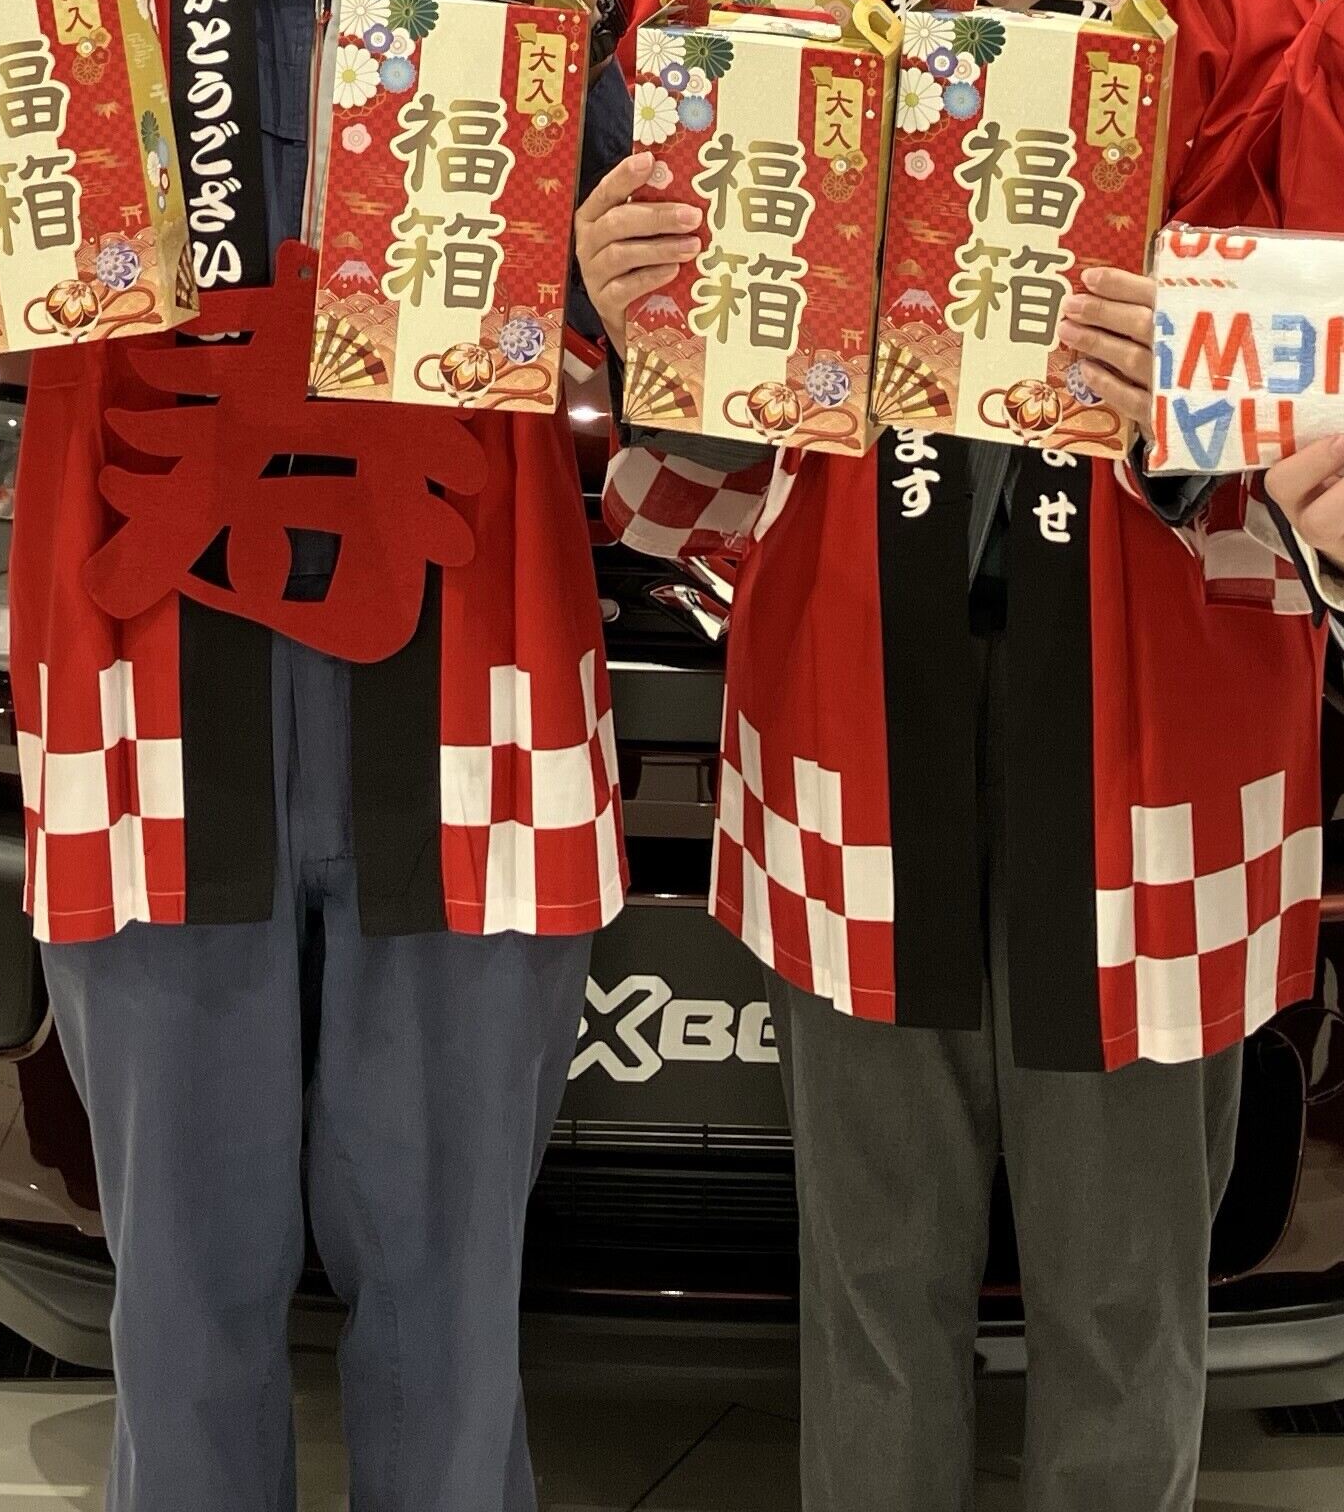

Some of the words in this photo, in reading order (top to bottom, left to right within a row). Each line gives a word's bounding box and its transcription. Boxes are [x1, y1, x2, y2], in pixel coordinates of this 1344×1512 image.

[385, 92, 510, 311] 福箱
[690, 131, 815, 351] 福箱
[948, 120, 1078, 348] 福箱
